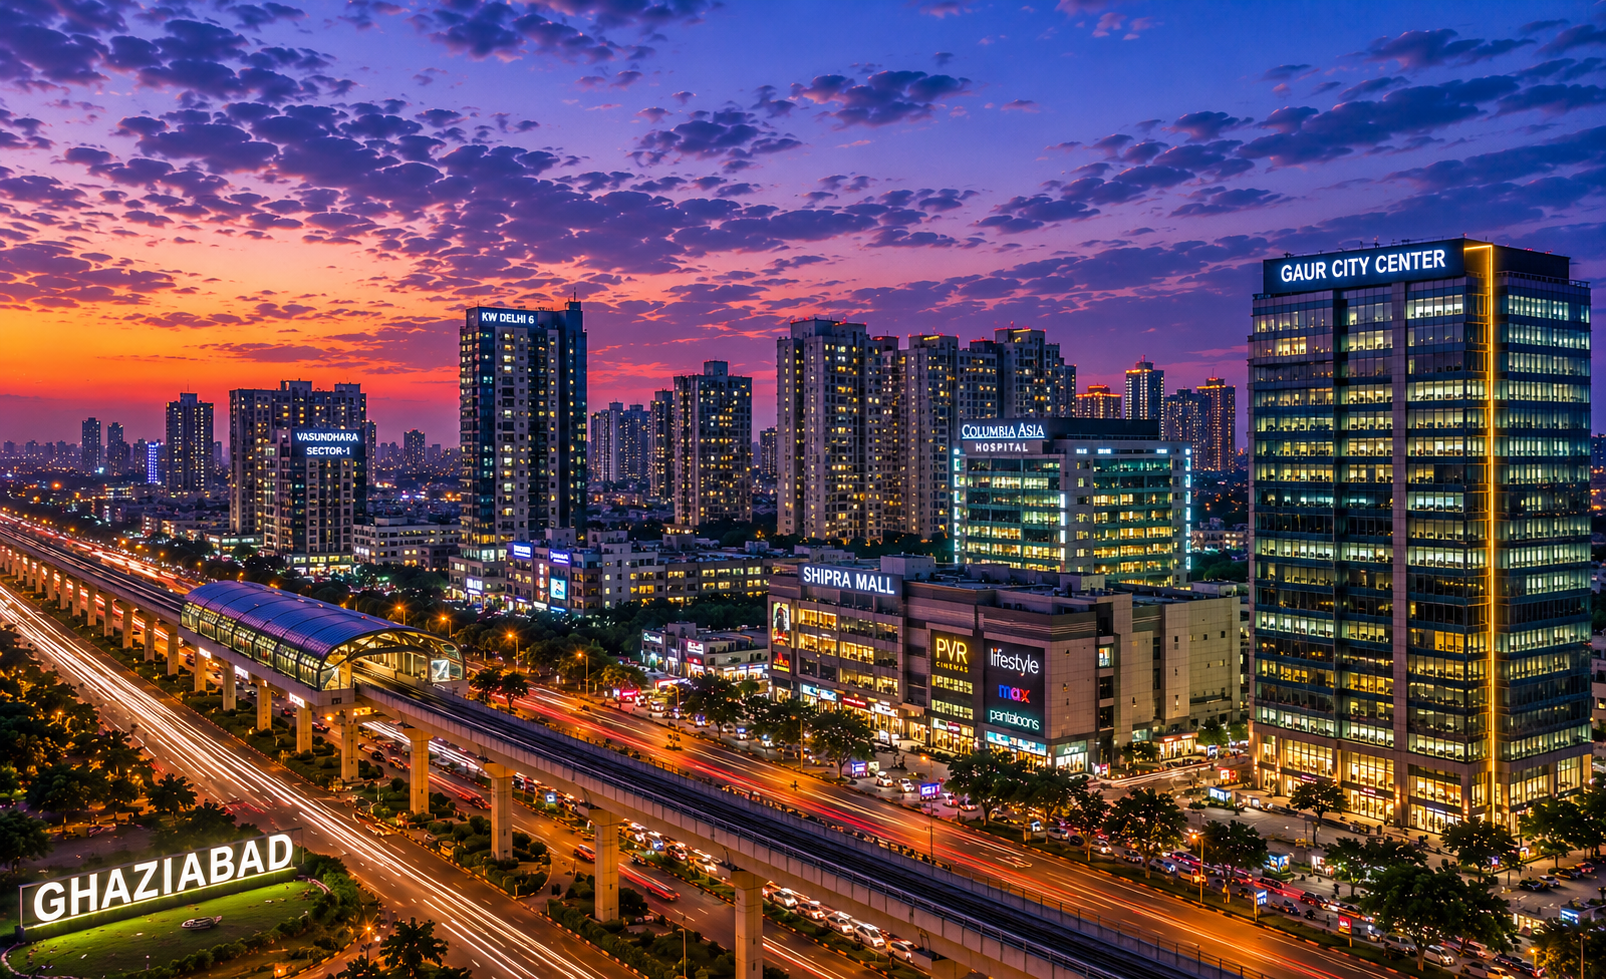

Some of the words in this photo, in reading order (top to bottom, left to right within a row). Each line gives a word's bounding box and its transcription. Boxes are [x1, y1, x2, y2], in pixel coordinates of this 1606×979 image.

[1281, 262, 1327, 283] GAUR
[1331, 257, 1370, 278] CITY
[1375, 249, 1446, 274] CENTER
[481, 312, 498, 322] KW
[499, 313, 526, 324] DELHI
[528, 315, 535, 325] 6
[296, 432, 359, 442] VASUNDHARA
[975, 442, 1029, 452] HOSPITAL
[306, 446, 351, 455] SECTOR-1
[803, 566, 852, 589] SHIPRA
[855, 573, 895, 595] MALL
[936, 637, 968, 665] PVR
[990, 647, 1040, 677] lifestyle
[998, 684, 1031, 704] max
[989, 709, 1040, 731] pantaloons
[33, 833, 294, 922] GHAZIABAD
